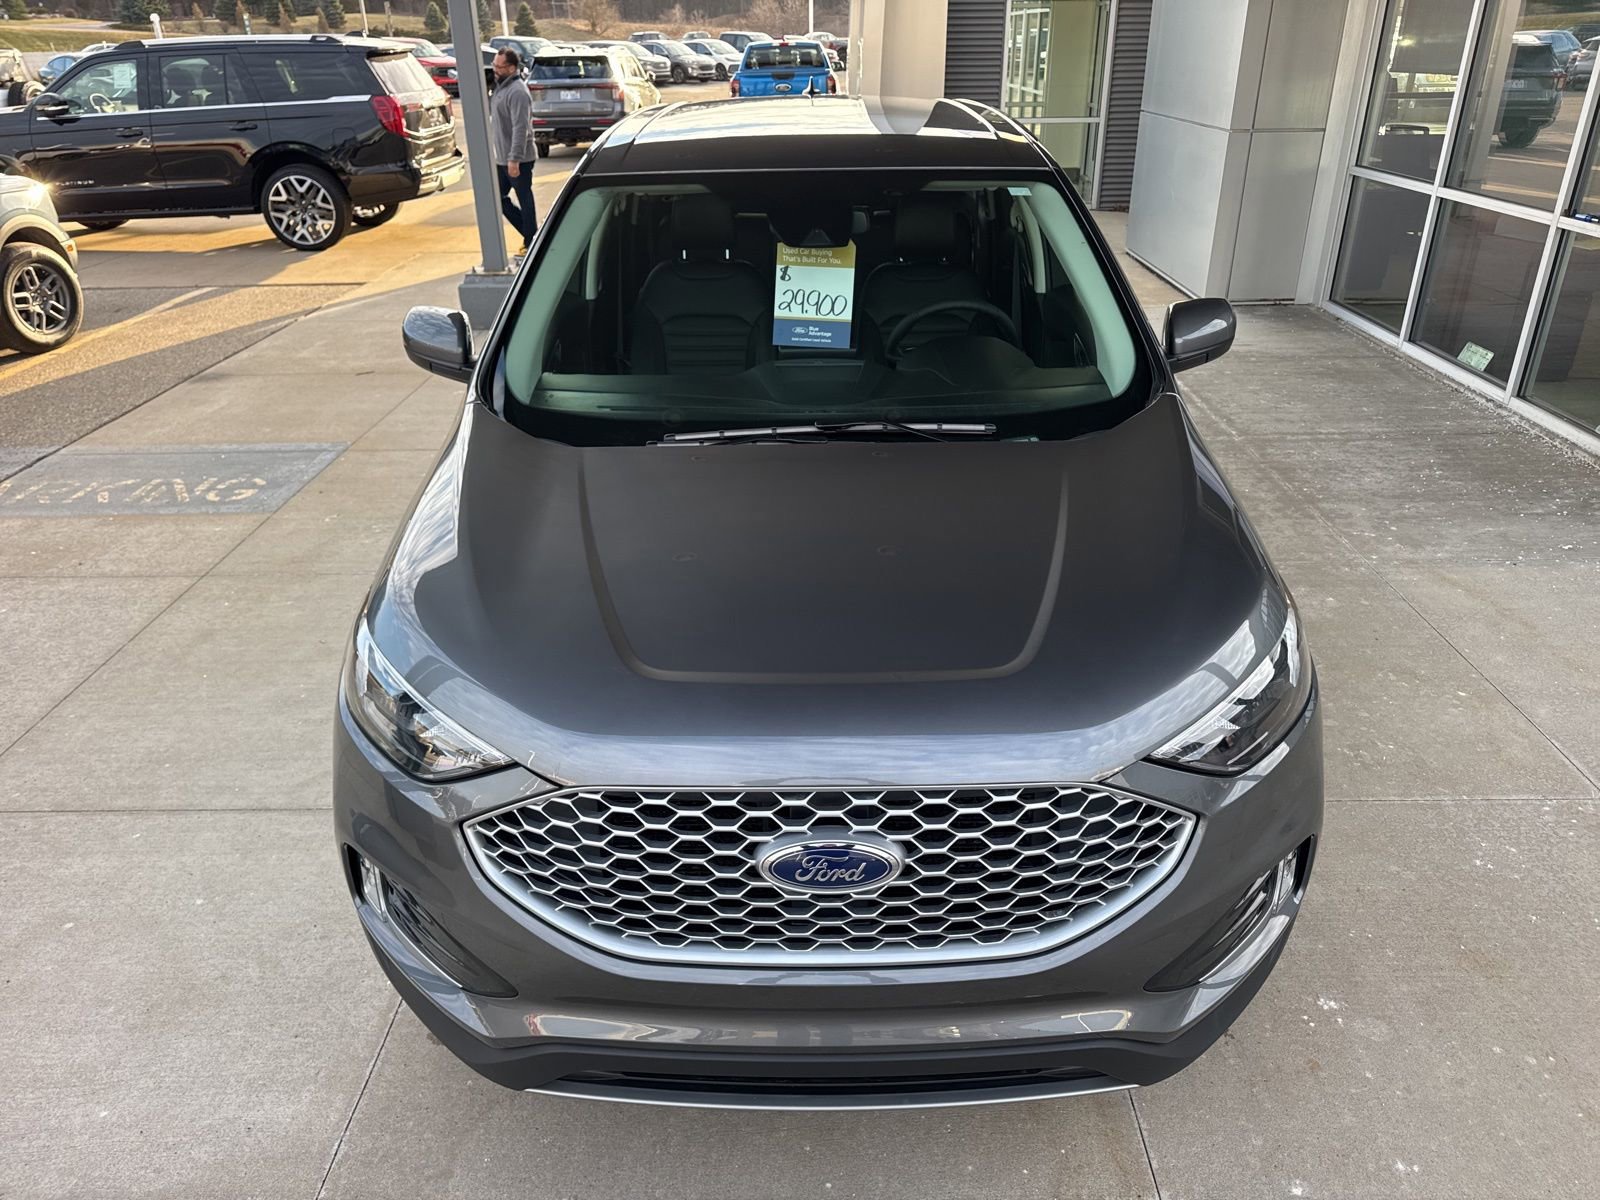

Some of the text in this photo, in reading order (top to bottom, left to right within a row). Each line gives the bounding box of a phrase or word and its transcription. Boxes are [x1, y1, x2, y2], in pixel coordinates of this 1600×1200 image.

[783, 255, 801, 263] That's
[811, 249, 832, 257] Buying
[779, 265, 792, 282] $
[795, 855, 867, 882] Ford
